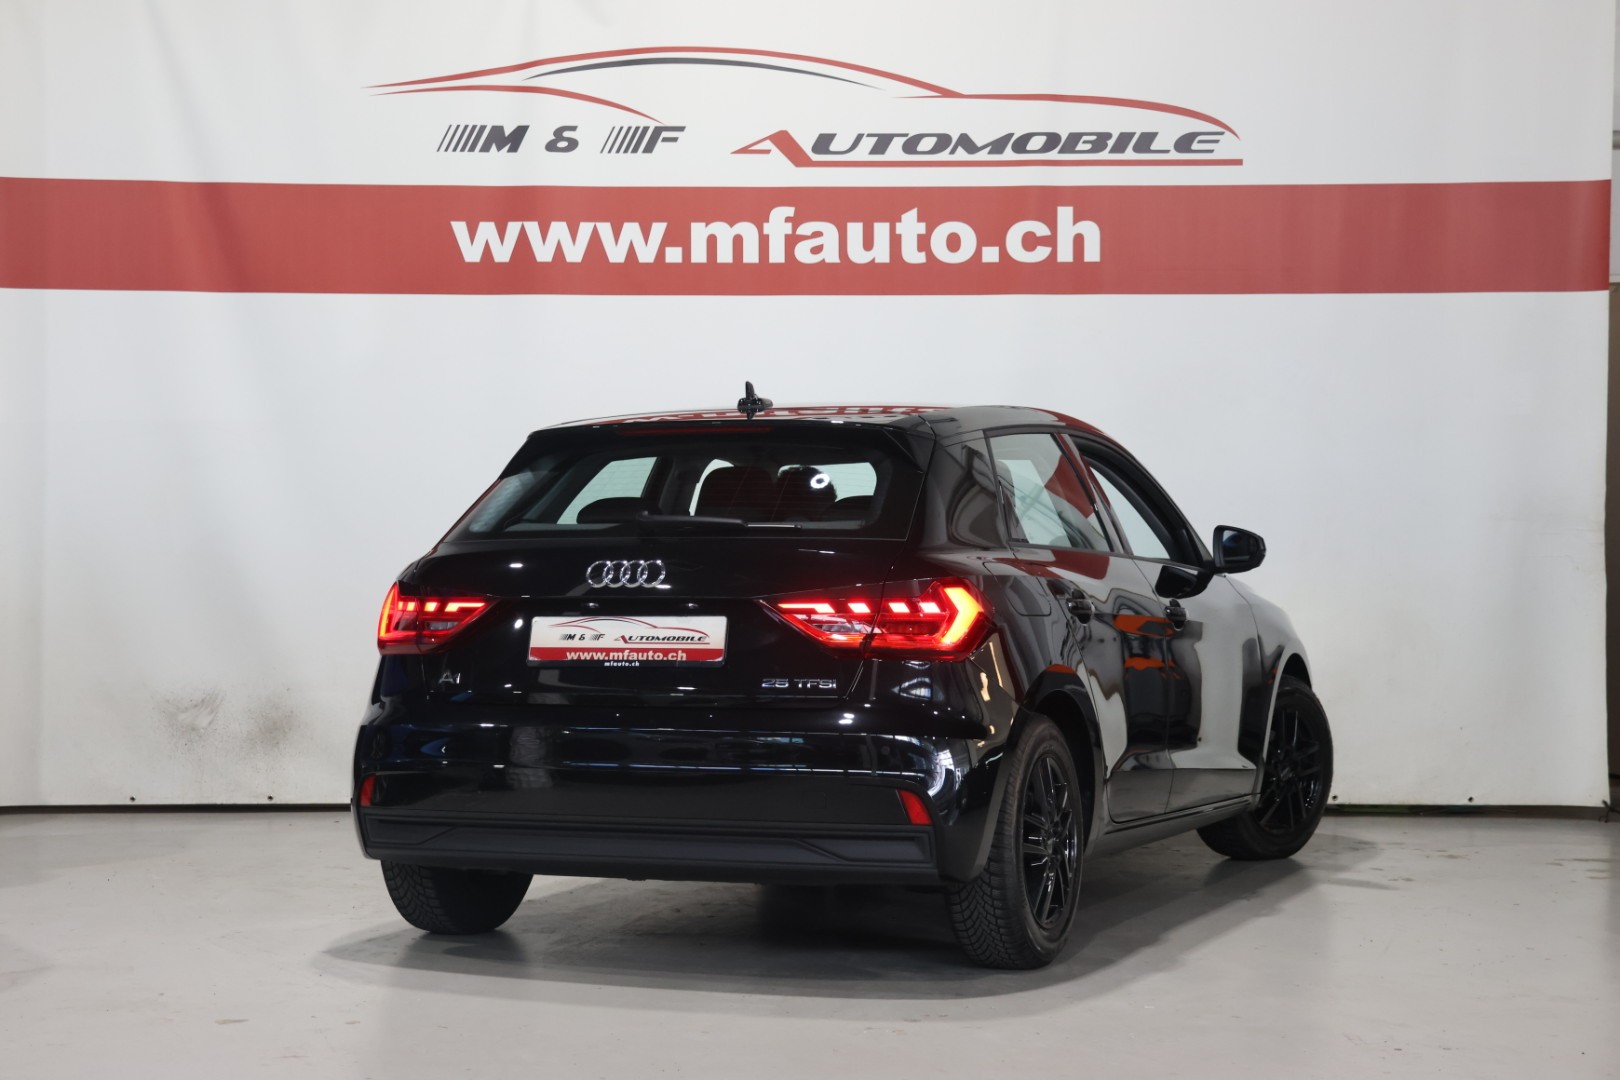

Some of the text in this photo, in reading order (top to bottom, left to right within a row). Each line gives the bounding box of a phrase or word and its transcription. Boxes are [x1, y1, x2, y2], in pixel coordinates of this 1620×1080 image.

[544, 125, 579, 153] &
[730, 130, 1226, 167] AUTOMOBILE
[450, 206, 1101, 264] www.mfauto.ch
[578, 633, 586, 641] &
[613, 635, 708, 644] AUTOMOBILE
[566, 649, 687, 661] www.mfauto.ch
[438, 671, 461, 685] A1
[761, 678, 837, 689] 25 TFSI
